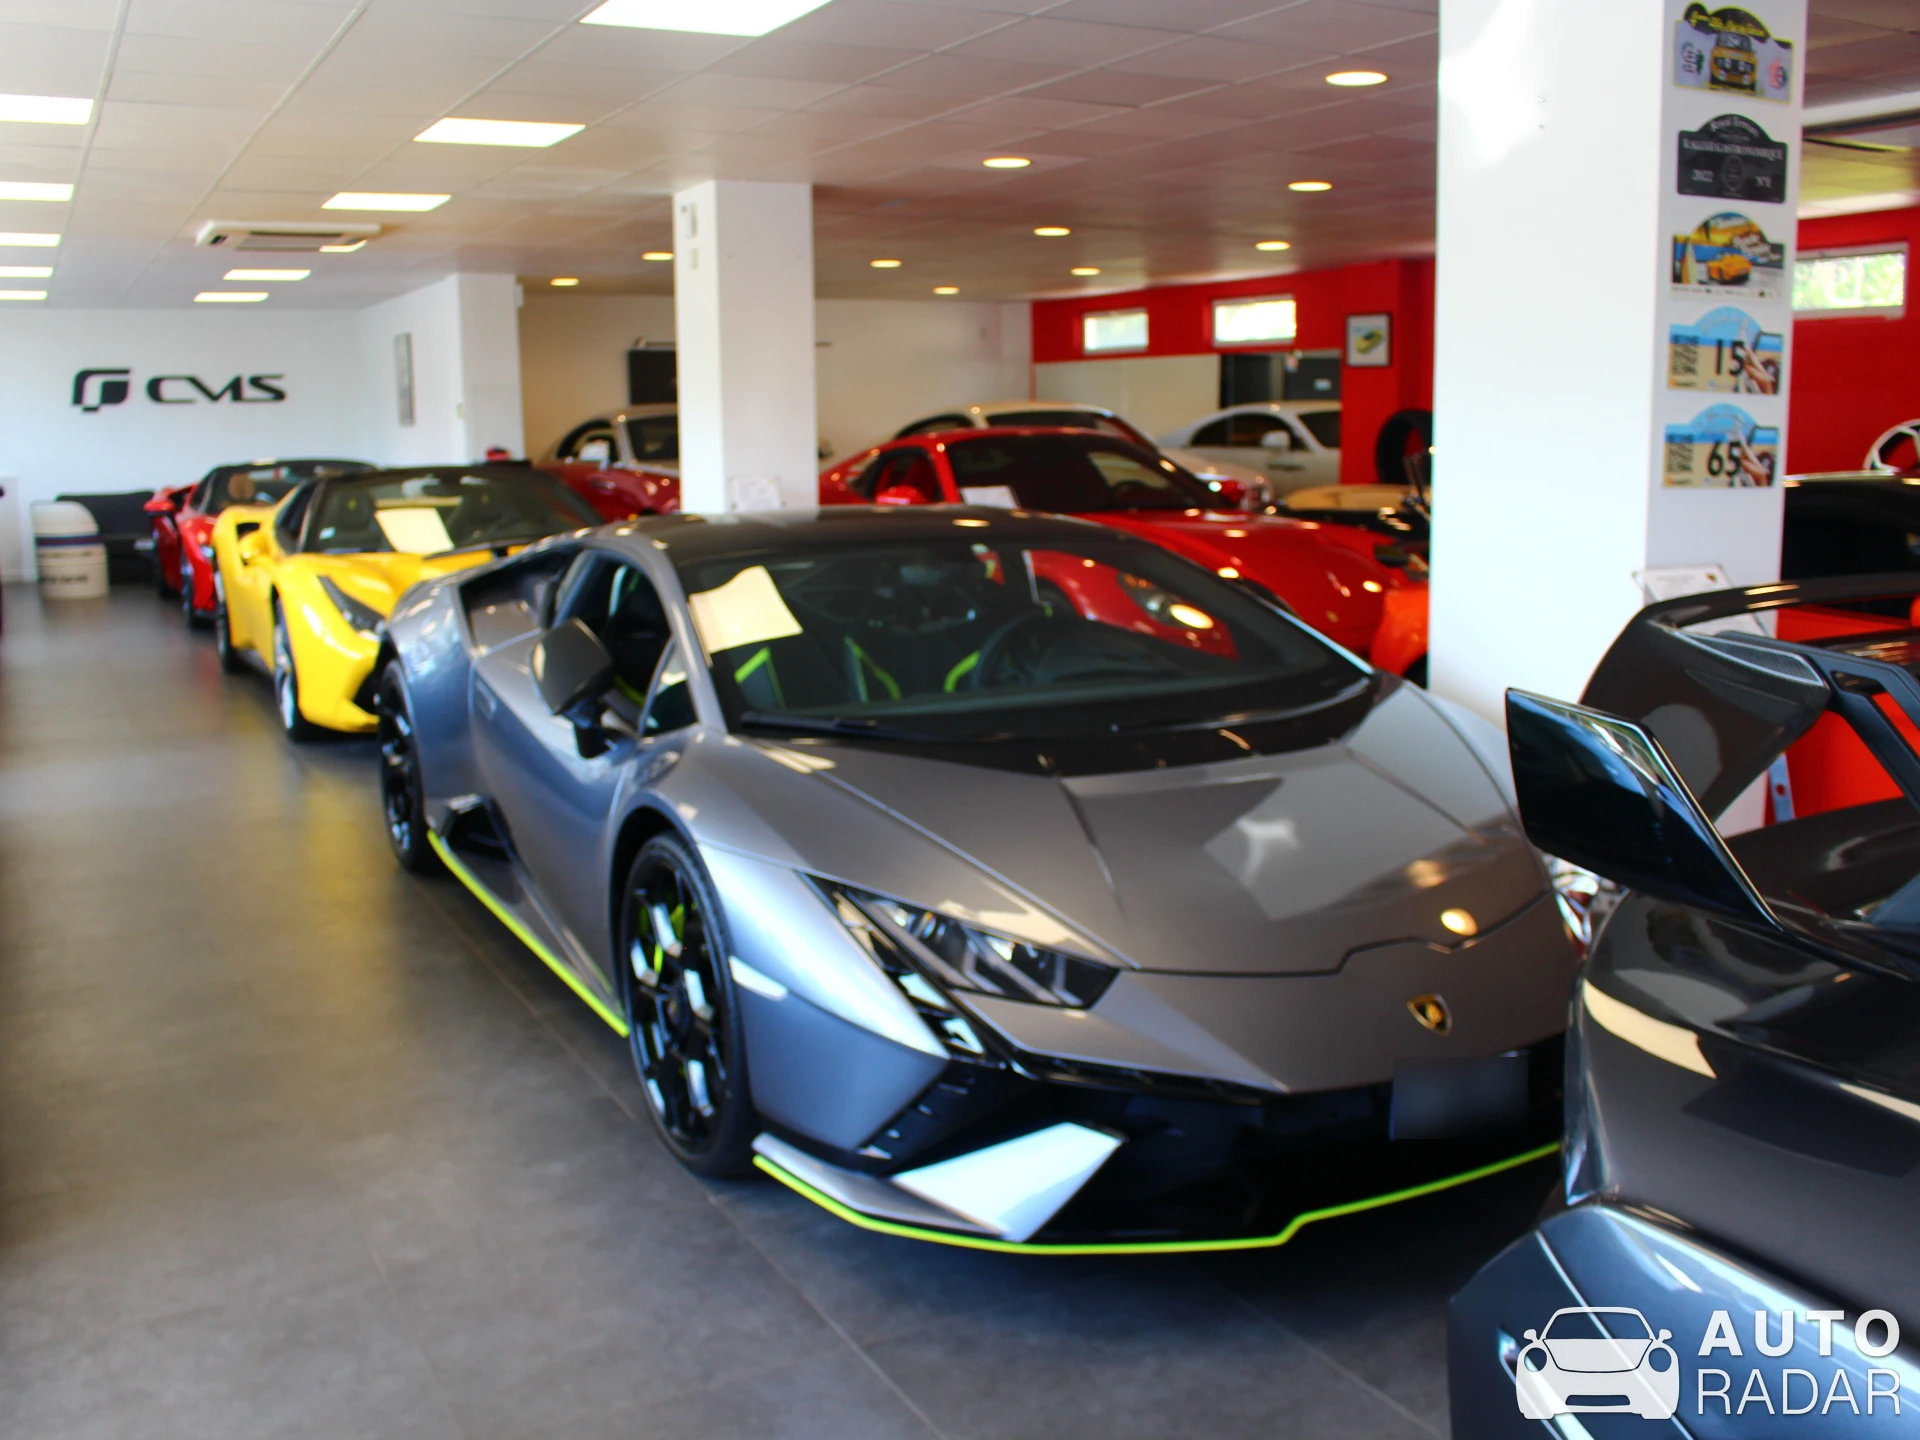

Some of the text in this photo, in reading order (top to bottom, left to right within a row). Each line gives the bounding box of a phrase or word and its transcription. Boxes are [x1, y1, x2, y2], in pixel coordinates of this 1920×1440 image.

[1715, 338, 1745, 376] 15
[146, 374, 286, 403] CMS
[1708, 439, 1741, 477] 65
